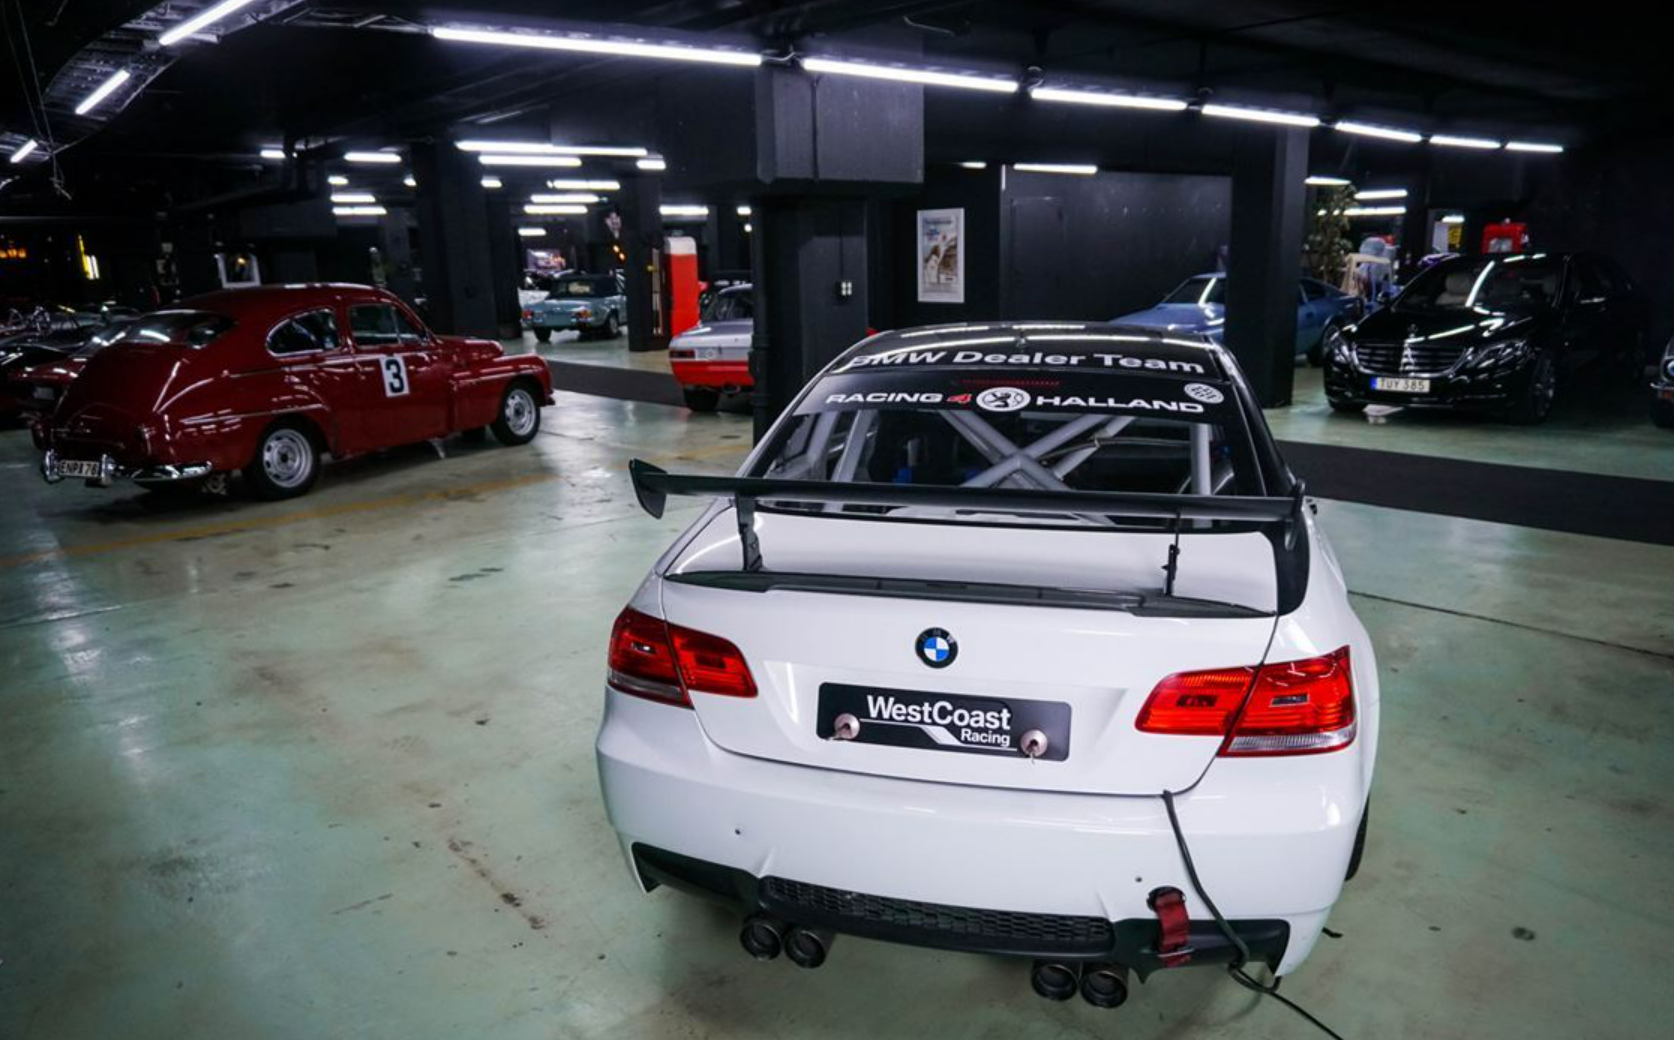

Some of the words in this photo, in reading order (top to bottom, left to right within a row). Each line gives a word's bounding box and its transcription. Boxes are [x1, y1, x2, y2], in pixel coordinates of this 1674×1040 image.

[850, 350, 947, 368] BMW
[953, 351, 1087, 365] Dealer
[1093, 353, 1205, 374] Team
[385, 358, 405, 393] 3
[826, 392, 943, 404] RACING
[947, 393, 972, 404] 4
[1036, 396, 1205, 413] HALLAND
[866, 694, 1011, 730] WestCoast
[960, 728, 1011, 748] Racing
